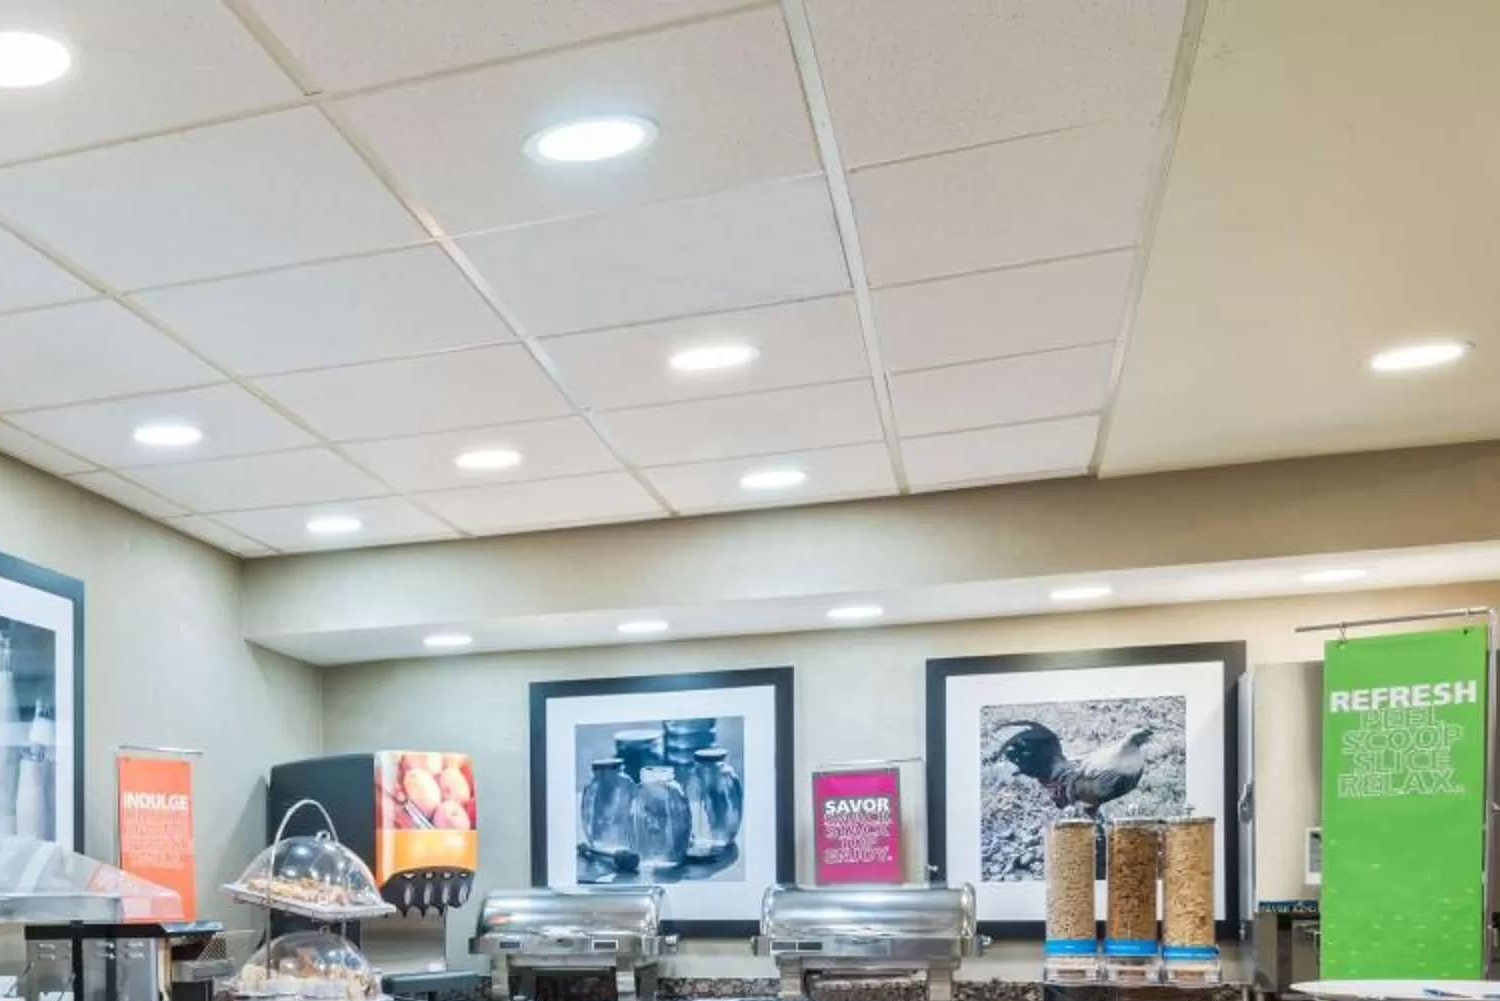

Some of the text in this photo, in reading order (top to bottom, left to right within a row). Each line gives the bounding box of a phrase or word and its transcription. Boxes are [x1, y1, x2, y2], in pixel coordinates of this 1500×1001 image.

[1330, 680, 1477, 713] REFRESH
[1360, 704, 1438, 733] PEEL
[1342, 722, 1464, 755] SCOOP
[1352, 750, 1453, 779] SLICE
[1337, 769, 1466, 799] RELAX.
[122, 792, 188, 811] INDULGE
[825, 798, 889, 814] SAVOR
